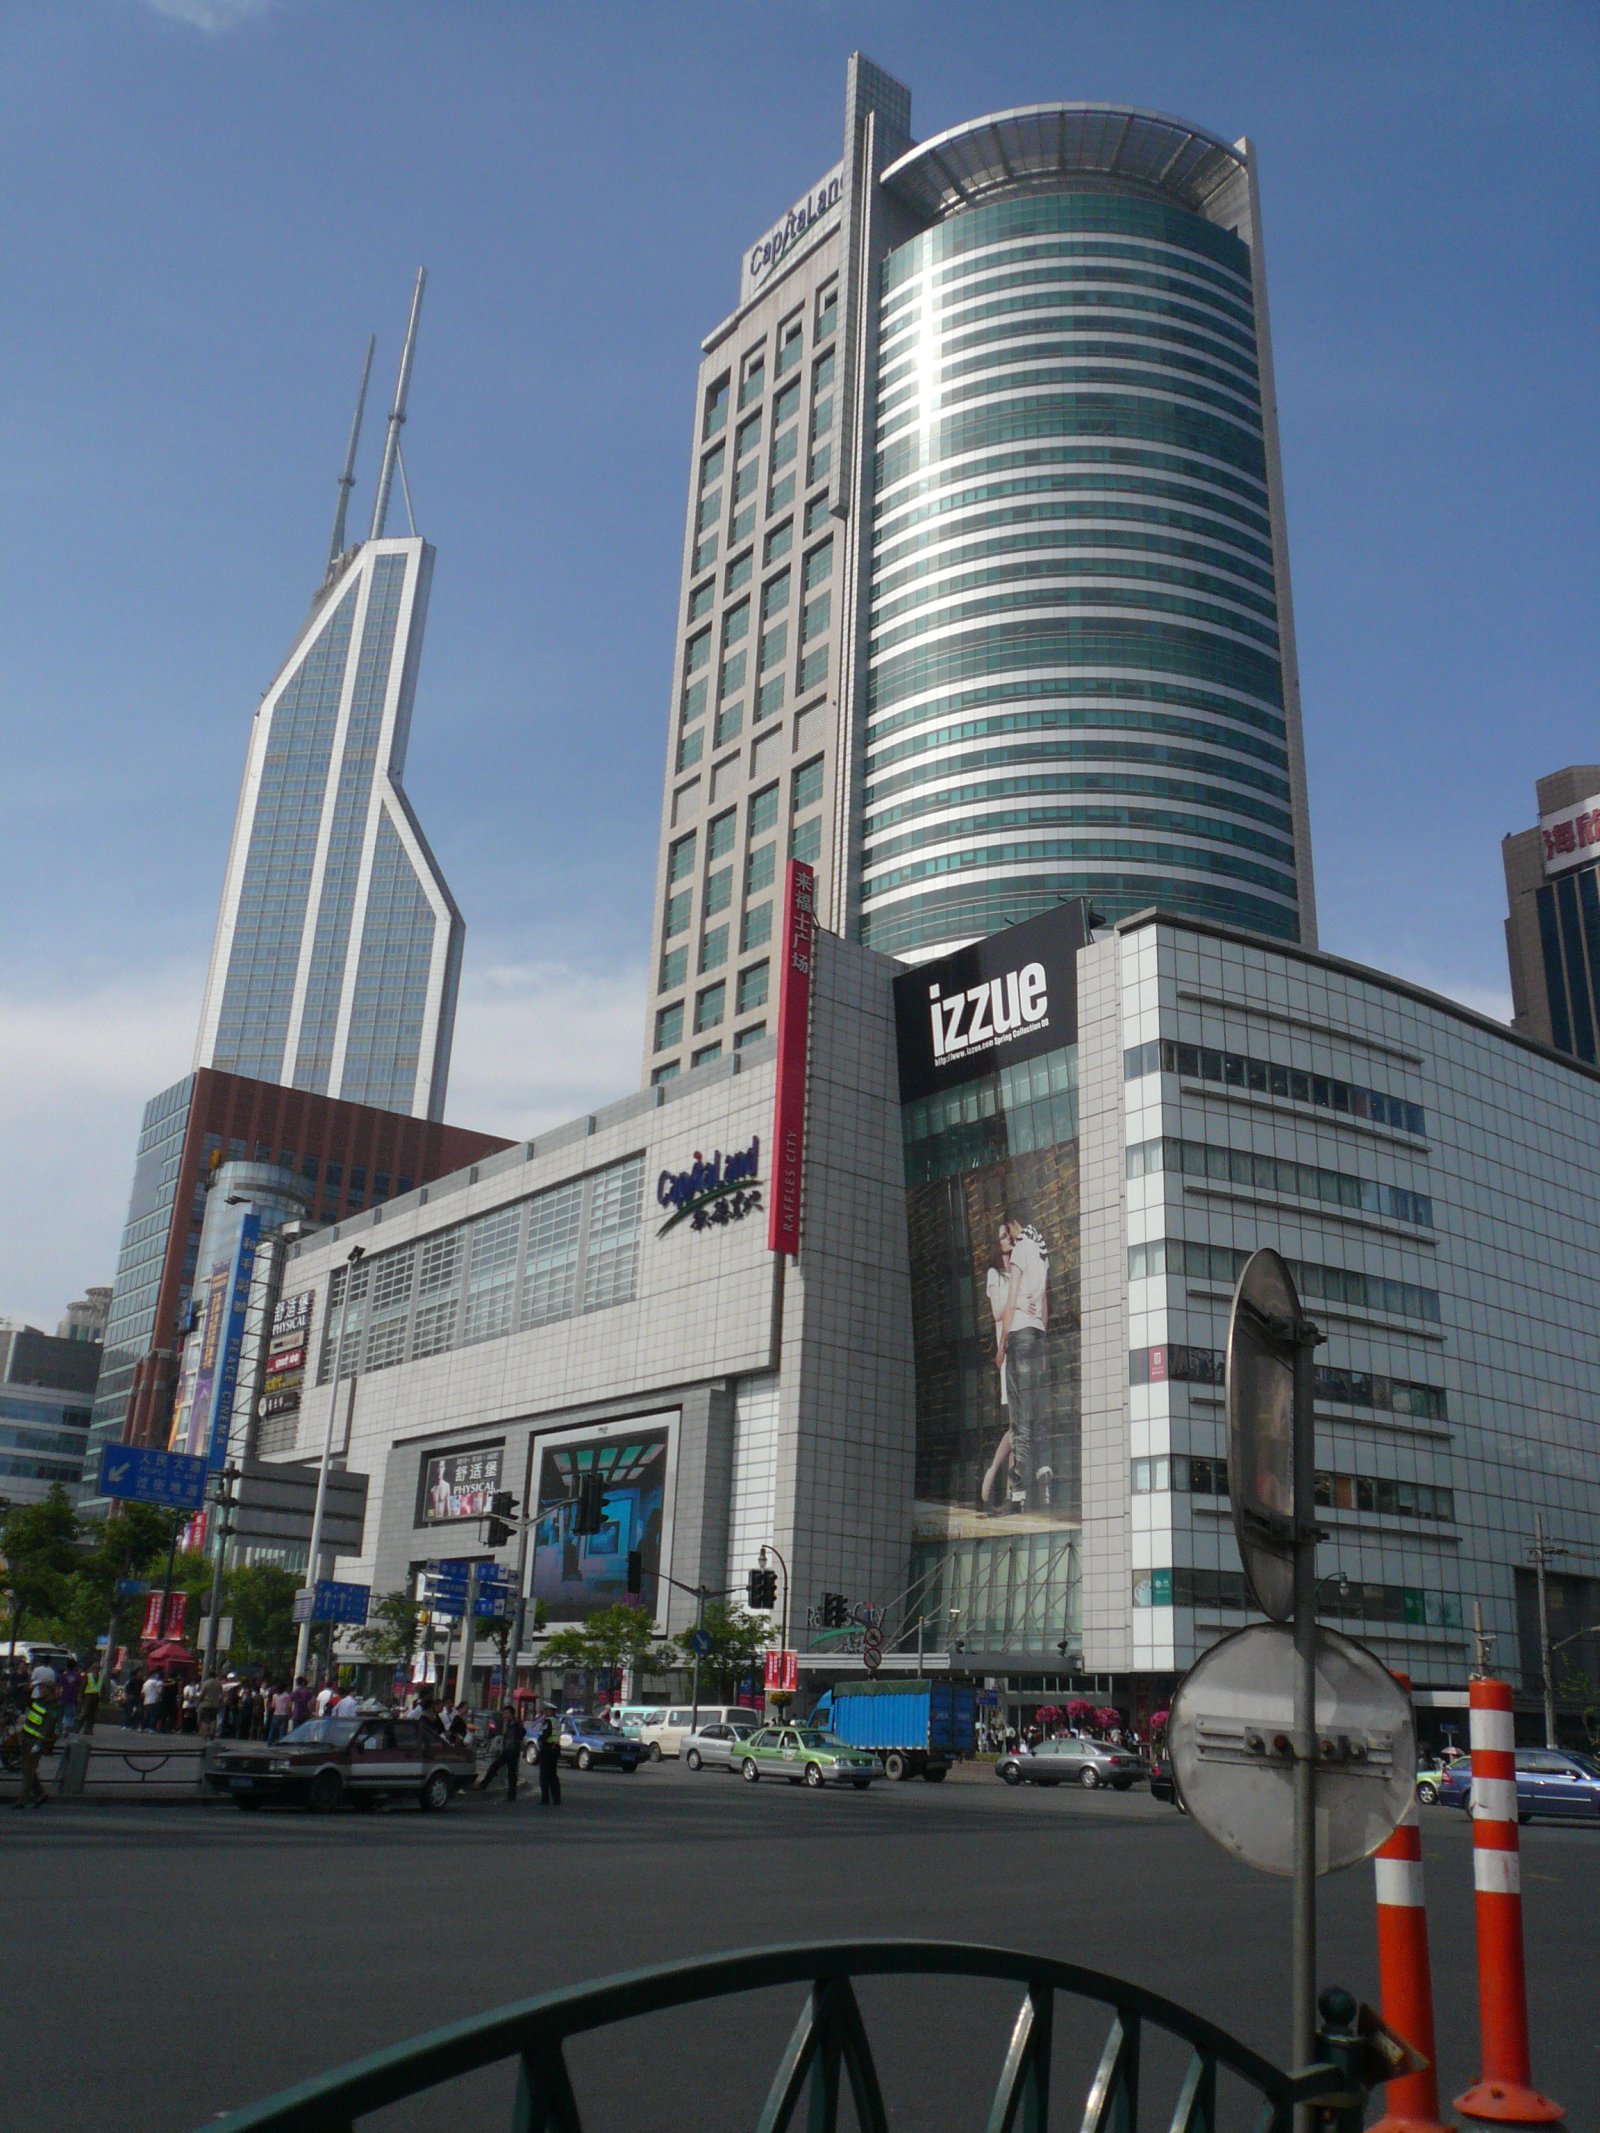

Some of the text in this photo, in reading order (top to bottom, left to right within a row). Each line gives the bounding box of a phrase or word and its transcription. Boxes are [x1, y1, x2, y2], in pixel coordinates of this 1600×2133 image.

[792, 871, 813, 974] 来福士广场
[929, 962, 1048, 1057] izzue
[994, 1033, 1013, 1046] Spring
[1012, 1022, 1041, 1038] Collection
[657, 1135, 760, 1211] CapitaLand
[783, 1130, 798, 1232] RAFFLES CITY
[272, 1315, 307, 1336] PHYSICAL
[215, 1337, 240, 1445] PEACE CINEMA
[453, 1480, 496, 1495] PHYSICAL
[455, 1461, 498, 1482] 舒适堡
